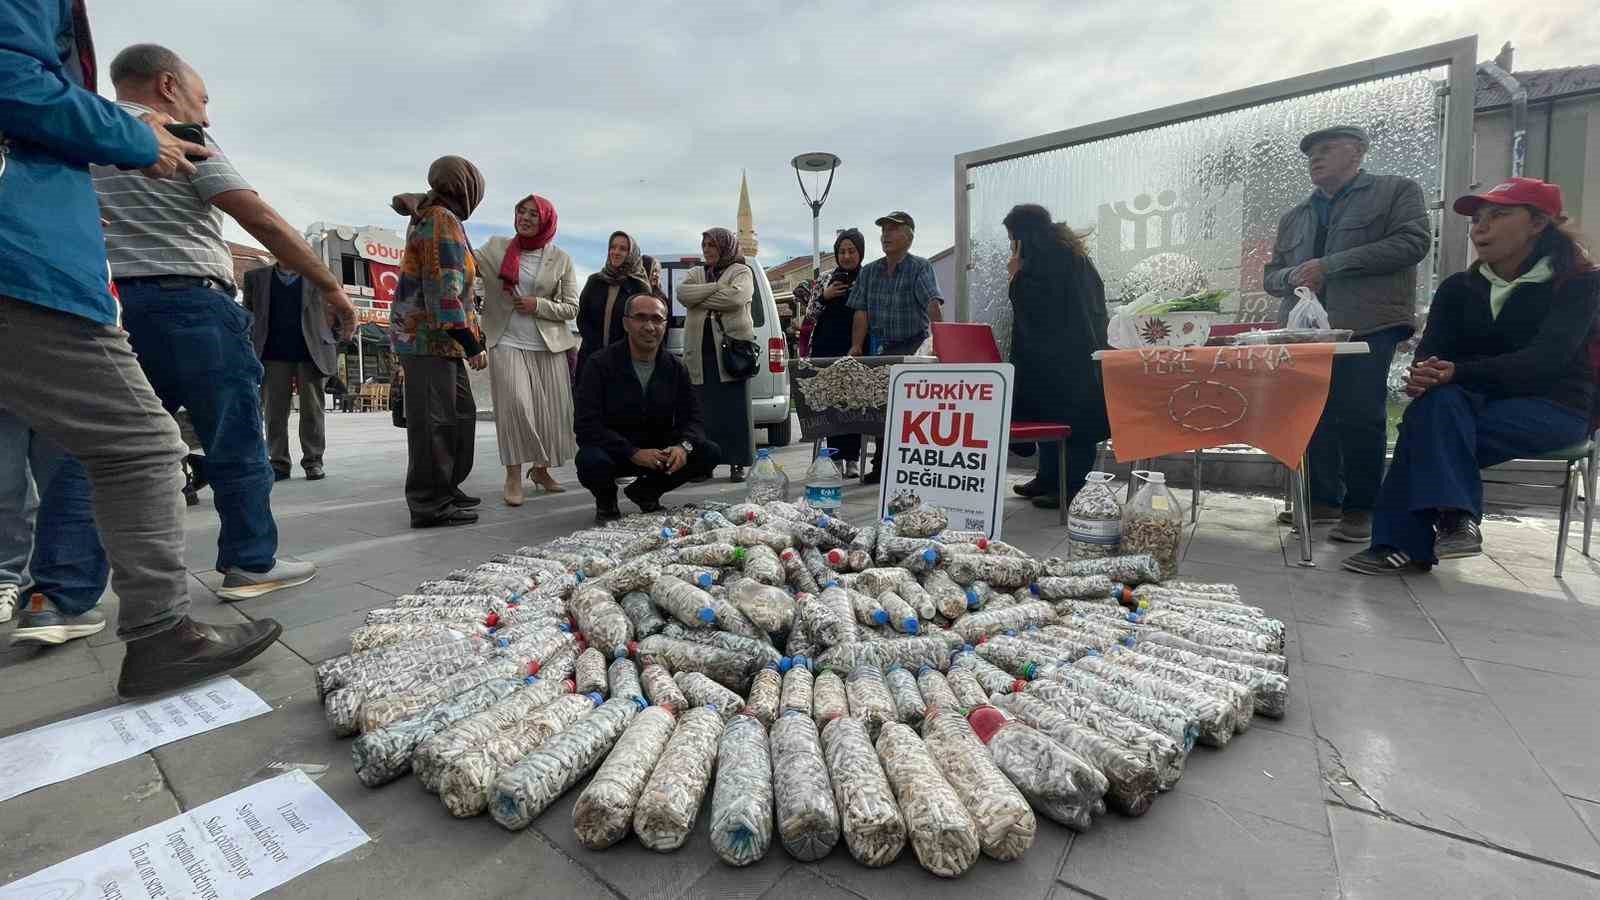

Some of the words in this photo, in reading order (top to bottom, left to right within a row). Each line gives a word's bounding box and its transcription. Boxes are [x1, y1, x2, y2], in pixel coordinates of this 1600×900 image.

[904, 380, 993, 401] TÜRKİYE
[901, 403, 988, 449] KÜL
[898, 447, 987, 470] TABLASI
[896, 469, 985, 493] DEĞİLDİR!
[254, 825, 288, 863] kirletiyor
